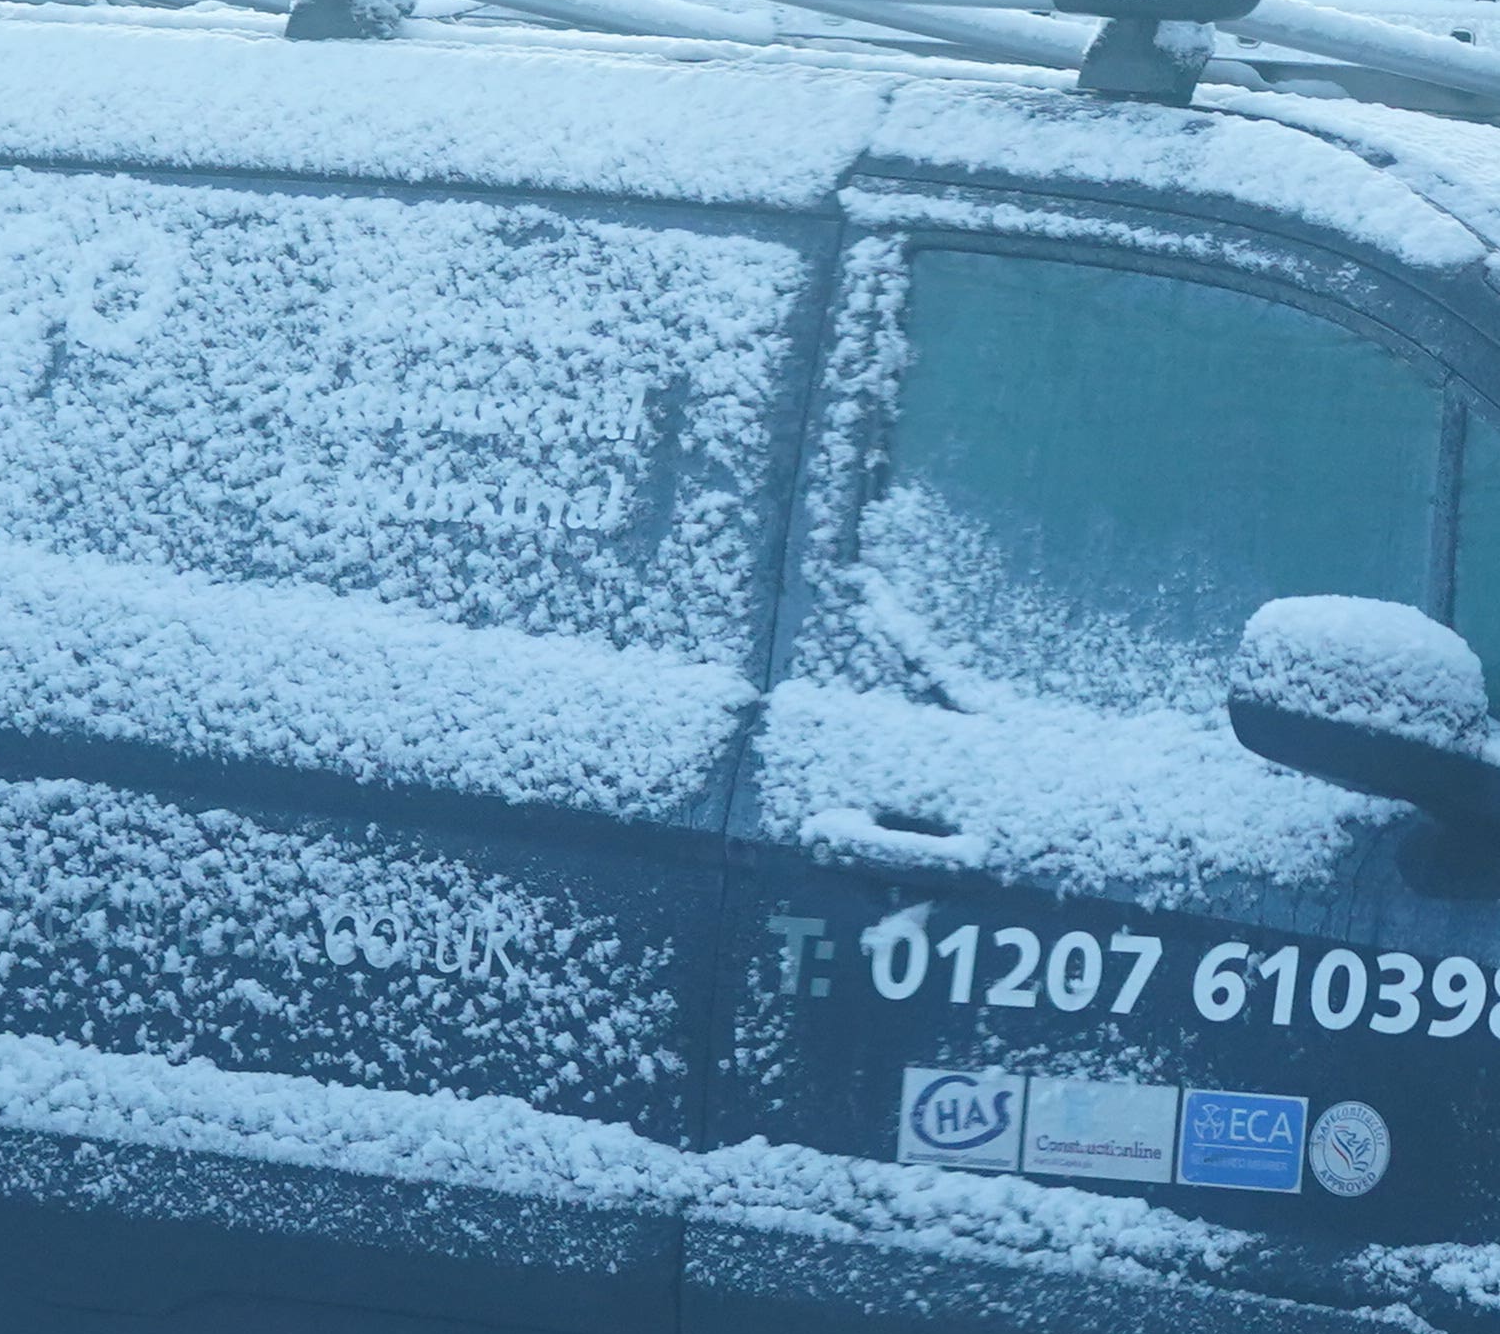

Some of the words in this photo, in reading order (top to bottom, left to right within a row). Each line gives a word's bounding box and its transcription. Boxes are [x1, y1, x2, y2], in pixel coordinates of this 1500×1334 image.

[869, 918, 1164, 1014] 01207
[910, 1074, 1014, 1150] CHAS
[1229, 1107, 1293, 1144] ECA
[1320, 1171, 1376, 1192] APPROVED
